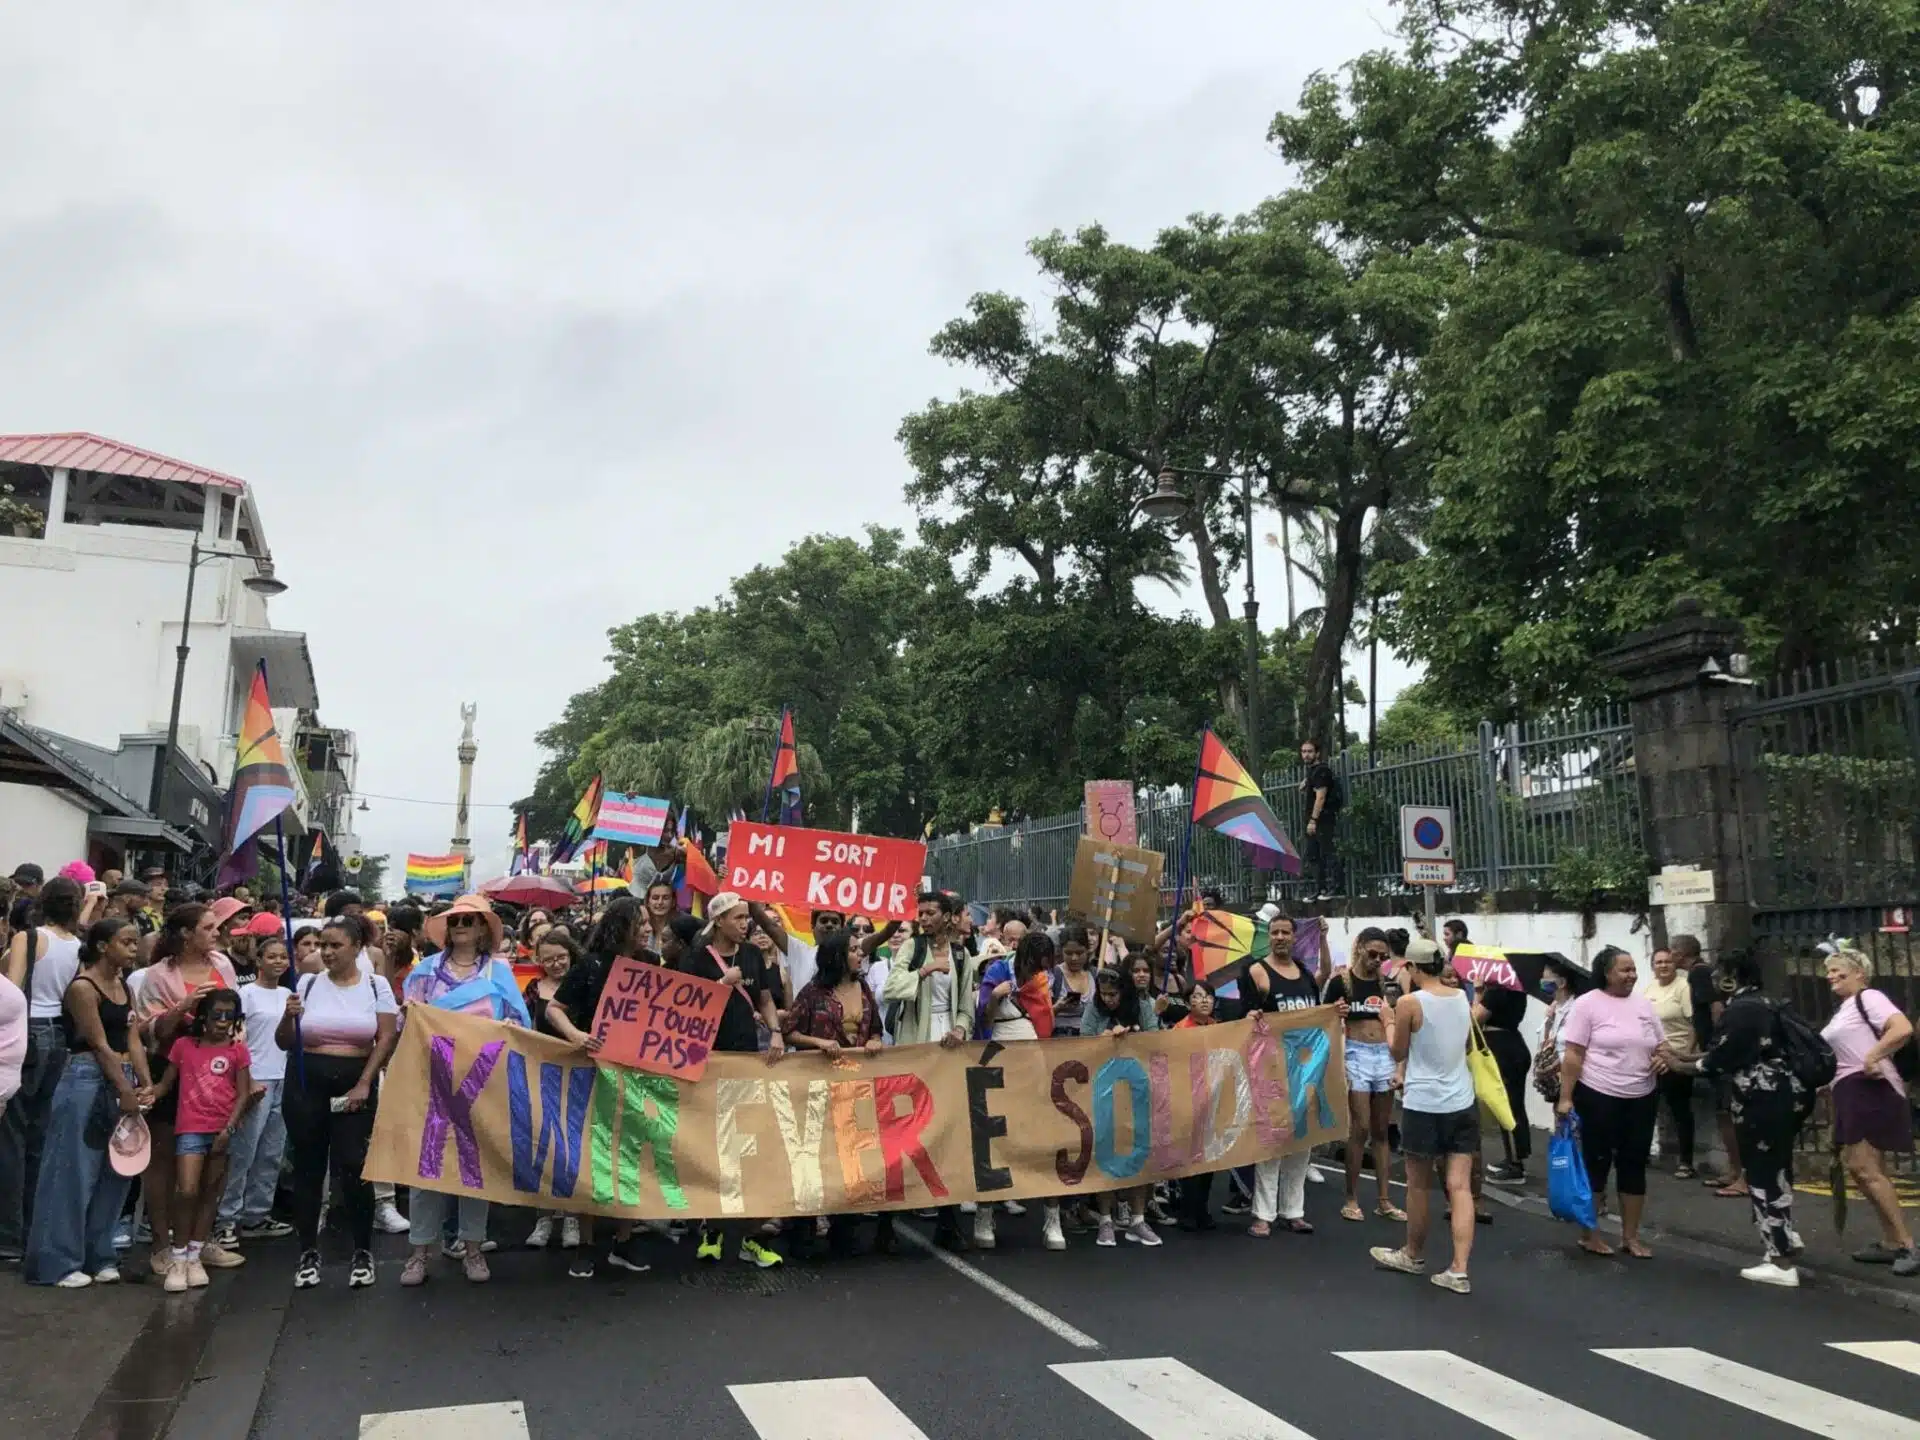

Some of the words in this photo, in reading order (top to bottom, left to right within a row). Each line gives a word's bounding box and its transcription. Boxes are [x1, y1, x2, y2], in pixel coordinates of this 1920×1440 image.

[749, 832, 786, 857] MI
[815, 840, 878, 867] SORT
[732, 867, 785, 893] DAR
[807, 872, 907, 914] KOUR
[617, 968, 673, 1006] JAY
[673, 983, 712, 1012] ON
[1467, 959, 1517, 986] KWIR
[602, 996, 640, 1022] NE
[639, 1030, 688, 1069] PAS
[418, 1035, 689, 1210] KWIR
[966, 1041, 1013, 1192] É
